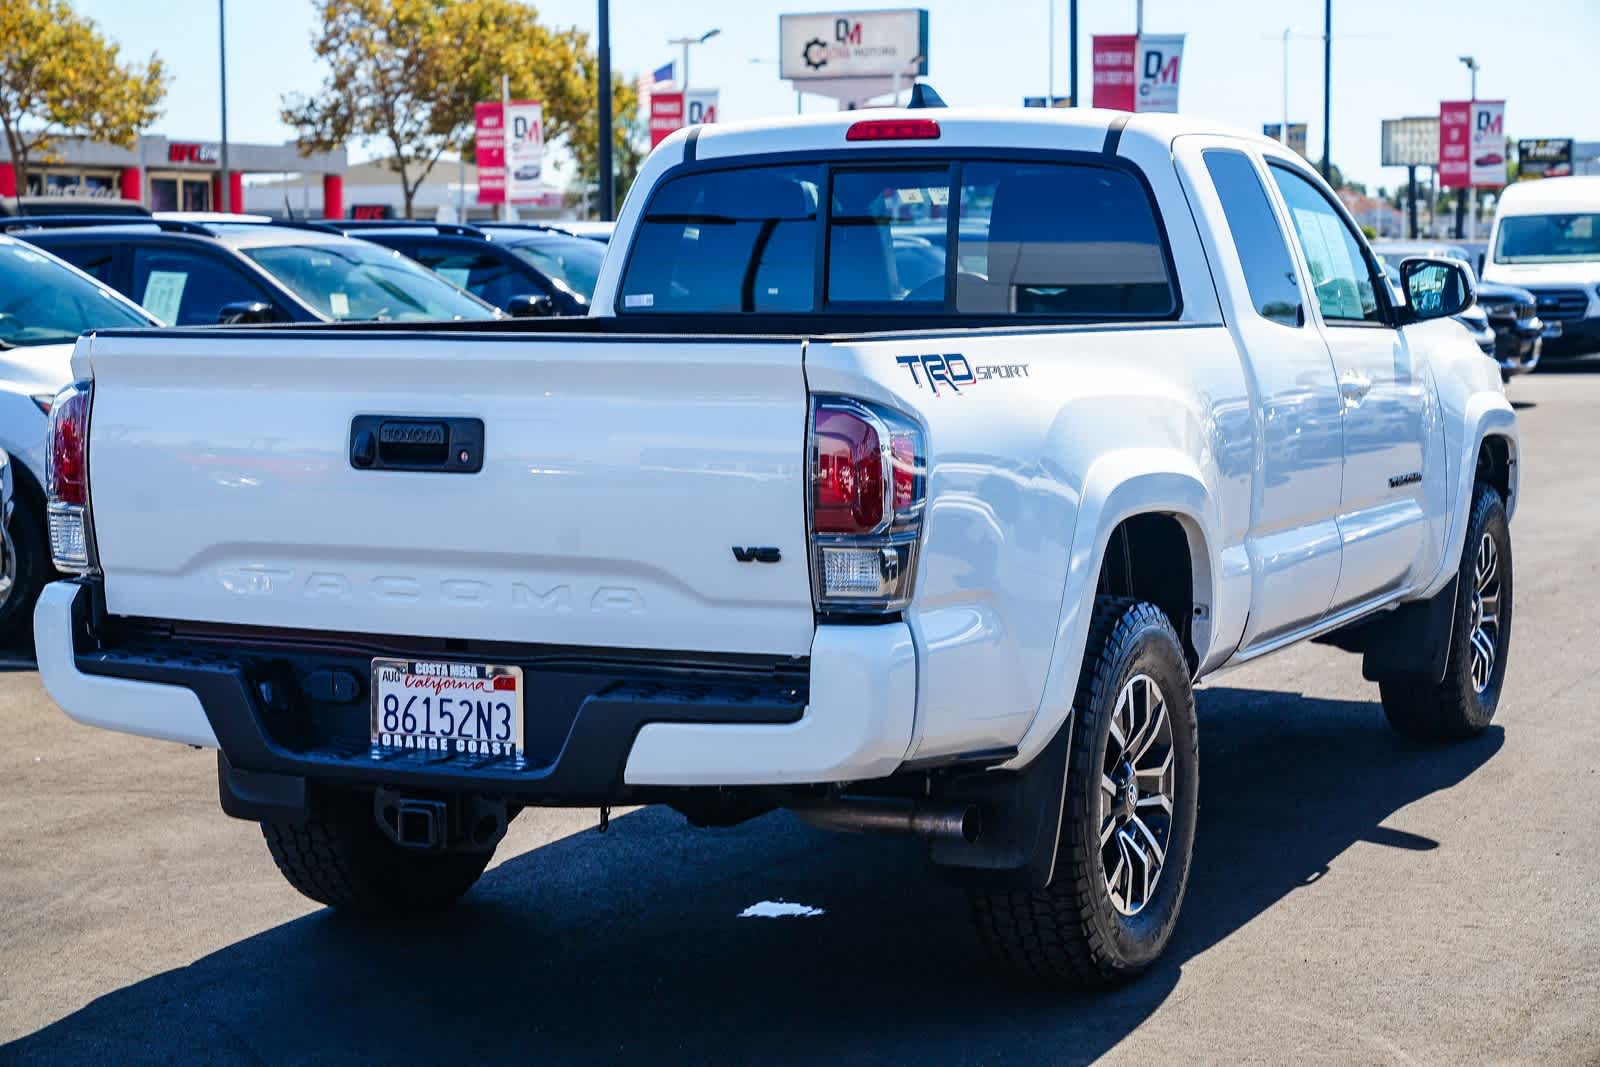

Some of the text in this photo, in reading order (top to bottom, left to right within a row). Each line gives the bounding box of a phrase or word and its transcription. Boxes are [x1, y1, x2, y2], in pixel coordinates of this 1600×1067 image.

[895, 353, 1030, 397] TRD SPORT
[382, 426, 442, 443] TOYOTA
[731, 545, 782, 564] V6
[234, 566, 648, 614] TACOMA
[382, 670, 401, 683] AUG
[415, 662, 479, 679] COSTA MESA
[404, 673, 486, 696] California
[383, 693, 512, 742] 86152N3
[381, 733, 513, 757] ORANGE COAST
